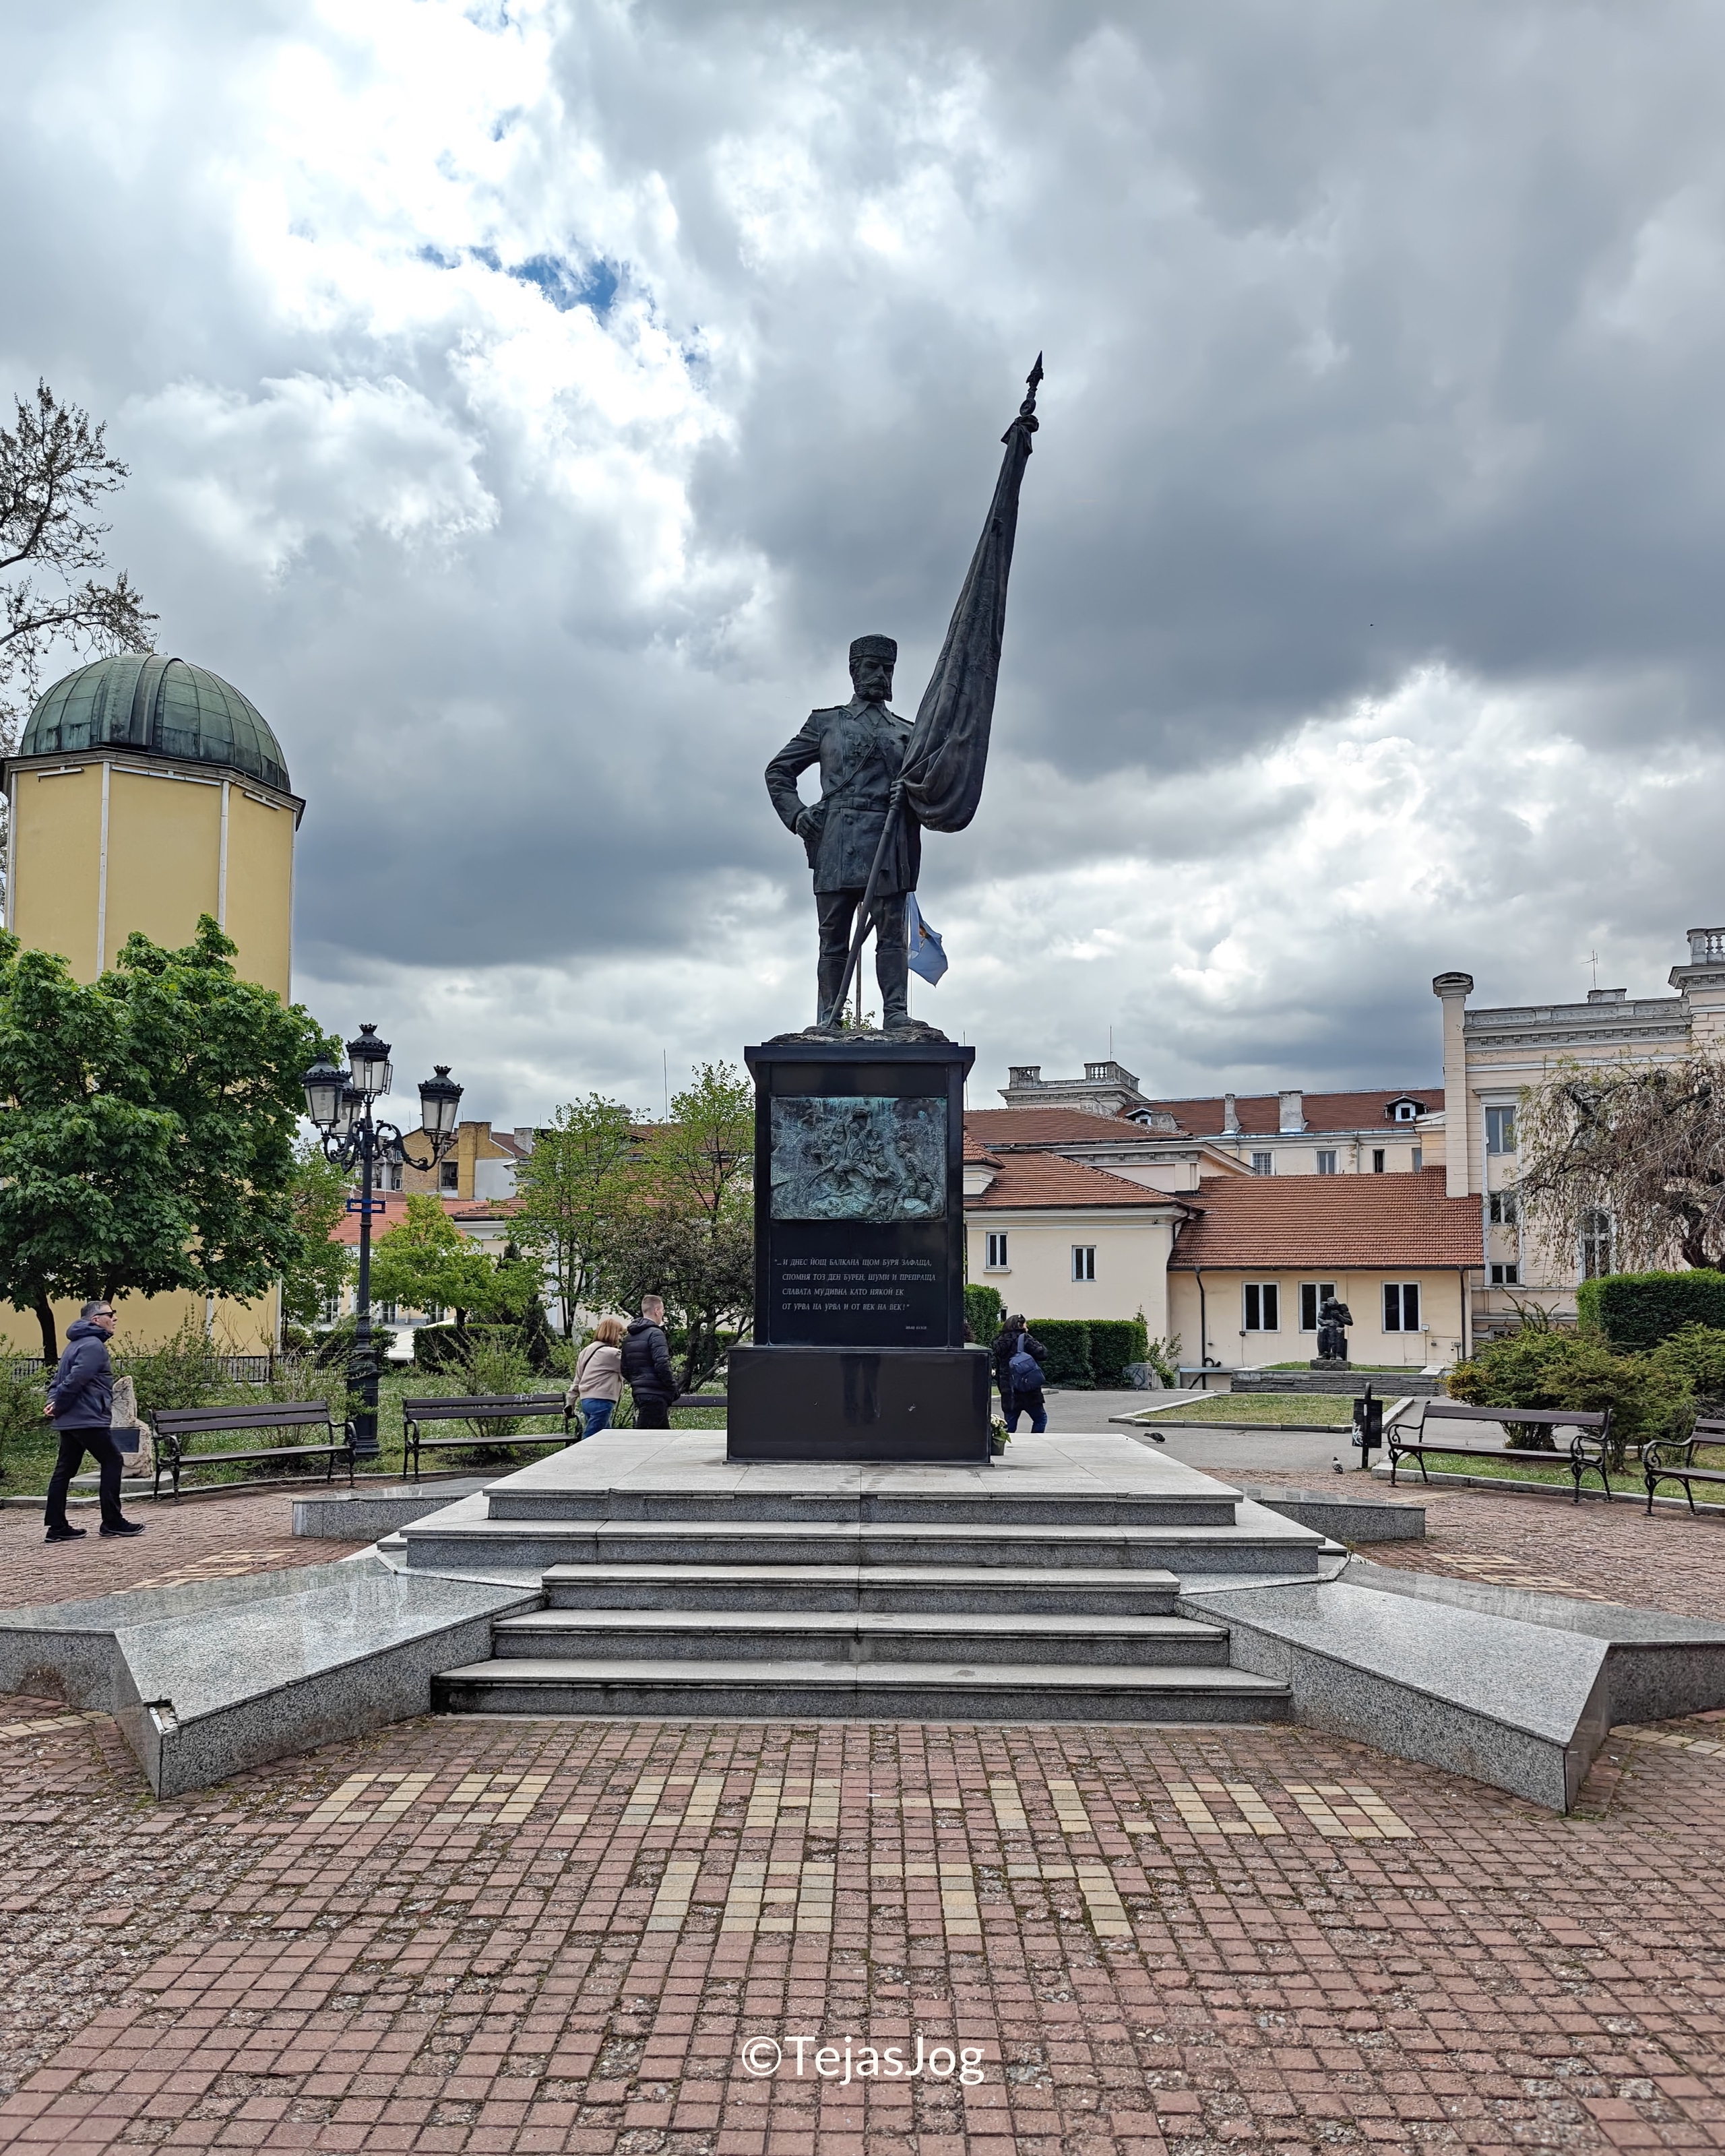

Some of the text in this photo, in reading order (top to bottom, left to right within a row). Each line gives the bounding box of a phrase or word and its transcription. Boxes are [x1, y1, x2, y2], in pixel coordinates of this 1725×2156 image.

[790, 1259, 808, 1267] ДНЕС
[862, 1259, 880, 1267] ЩОМ
[882, 1259, 900, 1267] БУРЯ
[901, 1259, 932, 1267] ЗАФАЩА,
[827, 1273, 842, 1281] ДЕН
[843, 1273, 866, 1282] БУРЕН,
[867, 1273, 890, 1282] ШУМИ
[899, 1273, 936, 1282] ПРЕПРАЩА
[813, 1288, 825, 1296] МУ
[825, 1288, 848, 1296] ДИВНА
[850, 1288, 868, 1296] КАТО
[869, 1287, 893, 1296] НЯКОЙ
[782, 1302, 793, 1310] ОТ
[794, 1302, 810, 1312] УРВА
[812, 1302, 822, 1310] НА
[824, 1302, 841, 1312] УРВА
[850, 1302, 862, 1310] ОТ
[646, 1860, 1134, 1937] 1877
